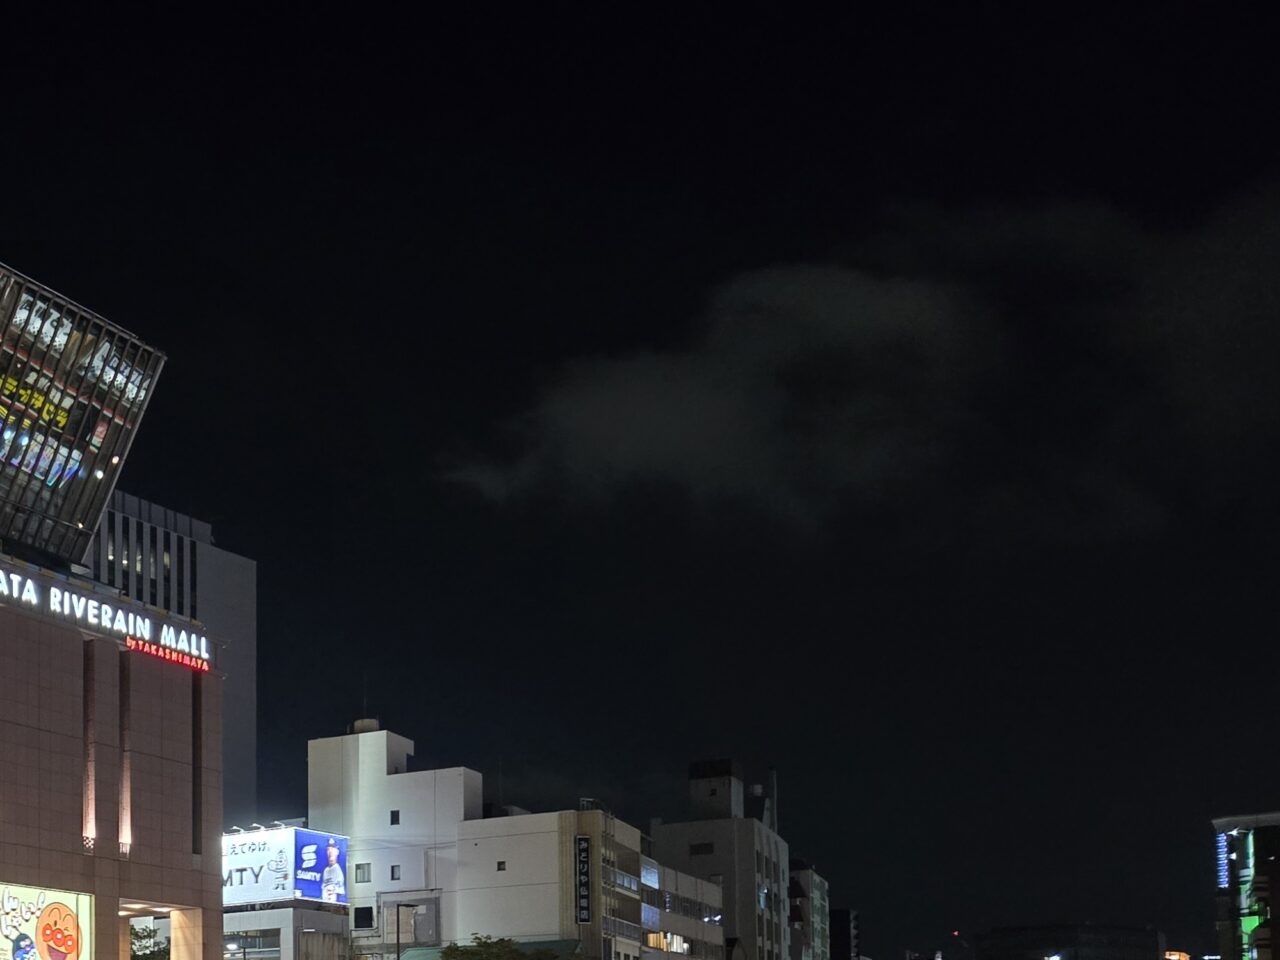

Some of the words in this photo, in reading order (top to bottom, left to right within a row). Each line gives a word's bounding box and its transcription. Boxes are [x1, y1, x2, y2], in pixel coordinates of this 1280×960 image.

[49, 586, 151, 641] RIVERAIN
[160, 623, 210, 660] MALL
[126, 635, 137, 650] by
[138, 640, 209, 671] TAKASHIMAYA
